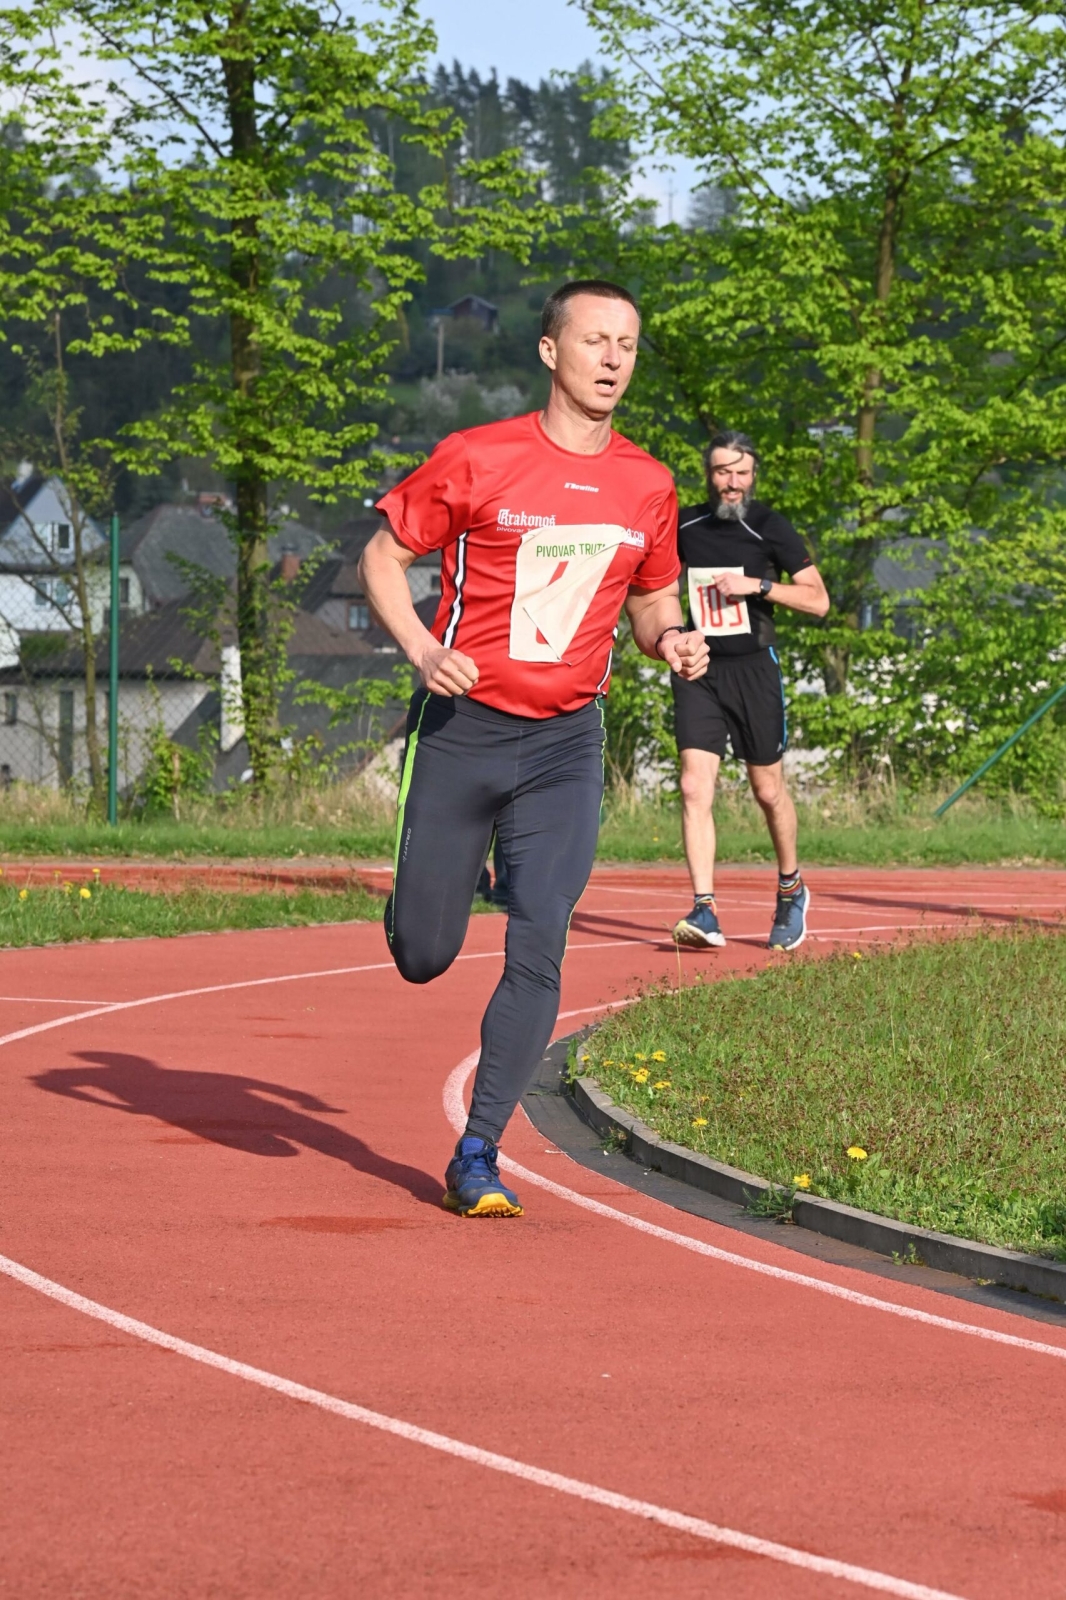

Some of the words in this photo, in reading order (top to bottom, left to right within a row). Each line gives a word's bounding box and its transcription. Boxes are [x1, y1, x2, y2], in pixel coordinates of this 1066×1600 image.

[497, 508, 557, 527] Krakonoš
[536, 544, 576, 558] PIVOVAR
[578, 542, 606, 556] TRUT
[403, 827, 412, 857] CRAFT
